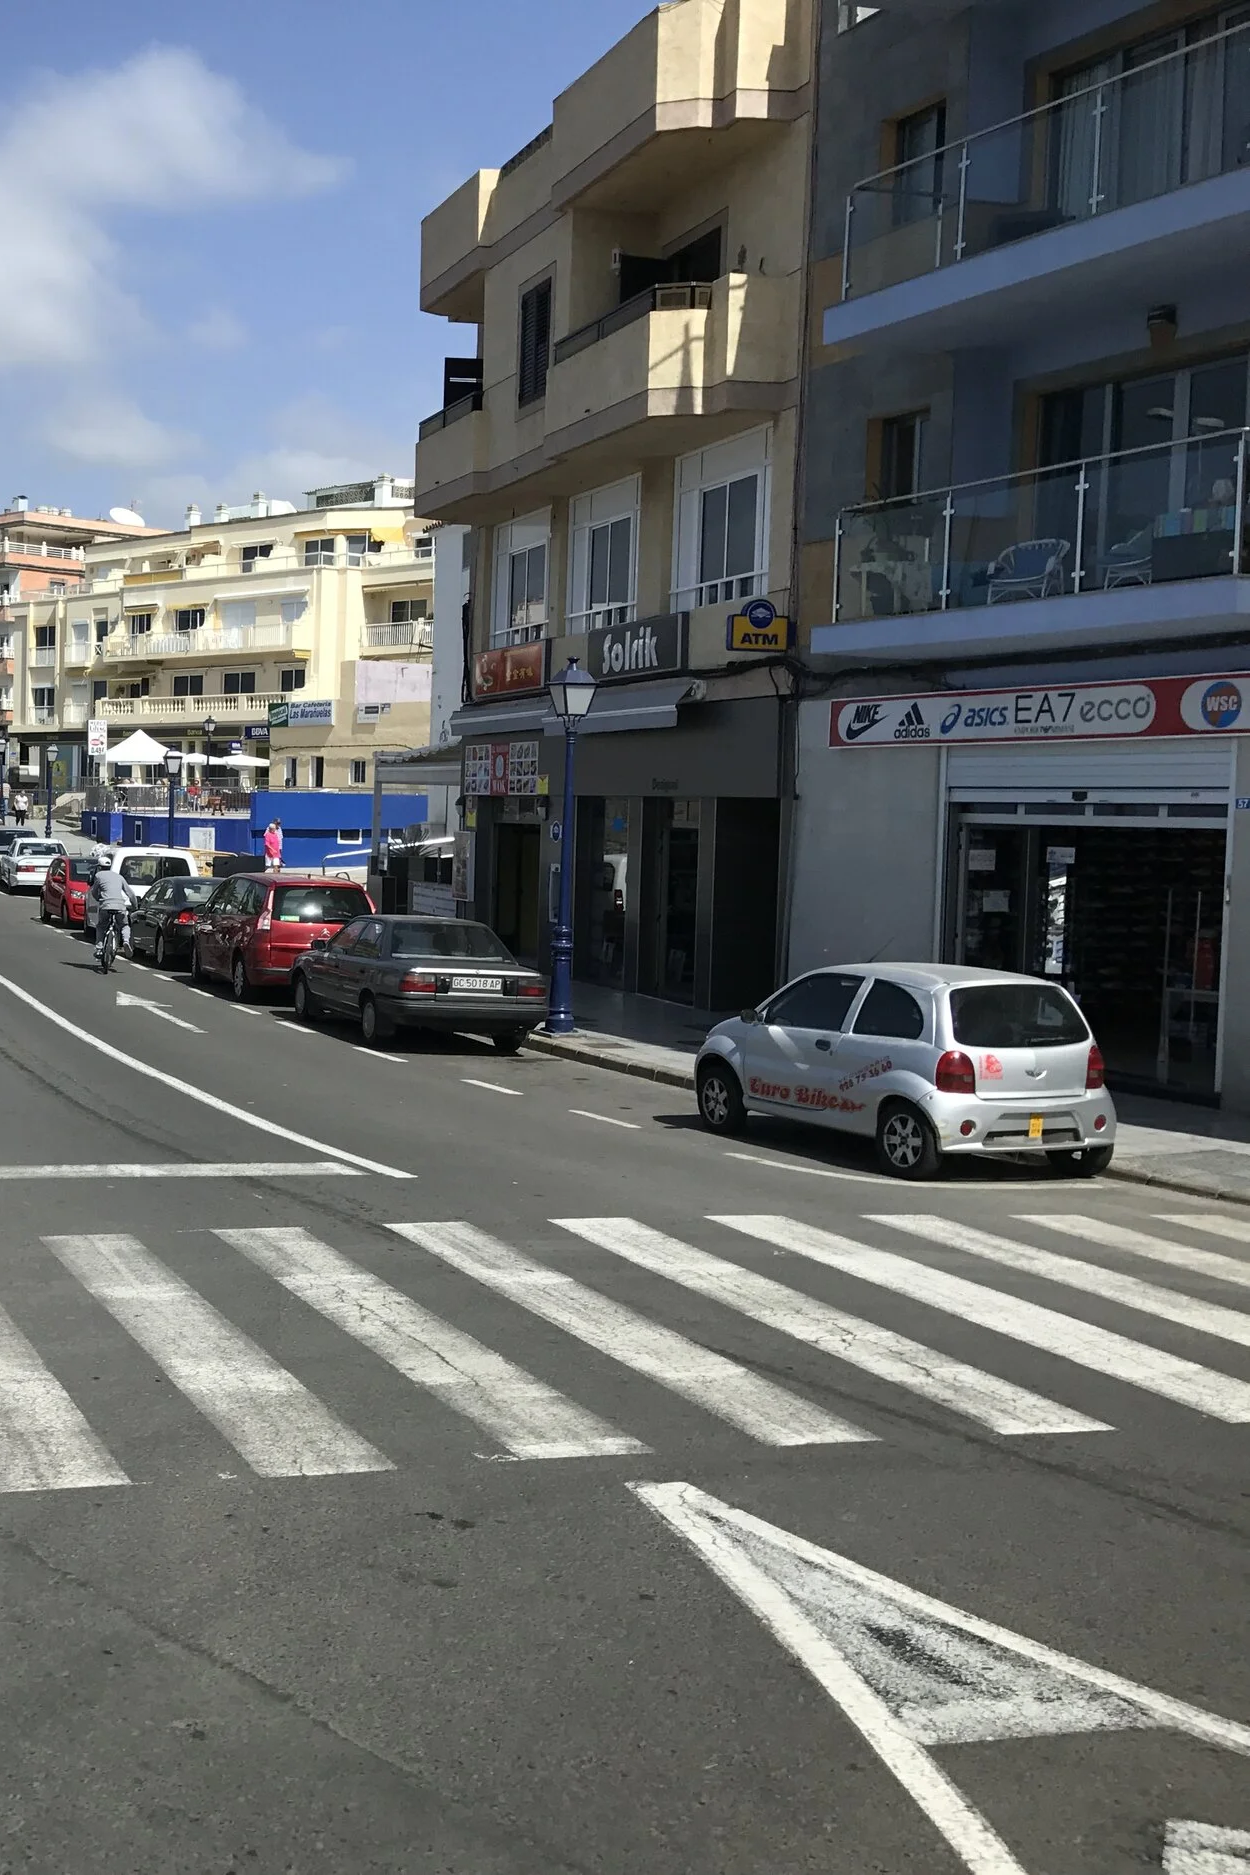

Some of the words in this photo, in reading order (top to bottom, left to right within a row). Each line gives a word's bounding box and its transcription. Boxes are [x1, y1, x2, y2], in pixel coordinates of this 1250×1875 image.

[740, 633, 778, 645] ATM
[1014, 692, 1076, 724] EA7
[1080, 696, 1150, 722] ecco
[1206, 694, 1238, 712] WSC
[289, 709, 300, 719] Las
[852, 704, 883, 724] NIKE
[963, 705, 1008, 727] asics
[251, 727, 269, 736] BBVA
[893, 725, 930, 739] adidas
[1237, 799, 1249, 808] 57
[453, 978, 464, 987] GC
[466, 978, 489, 988] 5018
[490, 980, 501, 988] AP
[750, 1076, 791, 1100] Euro
